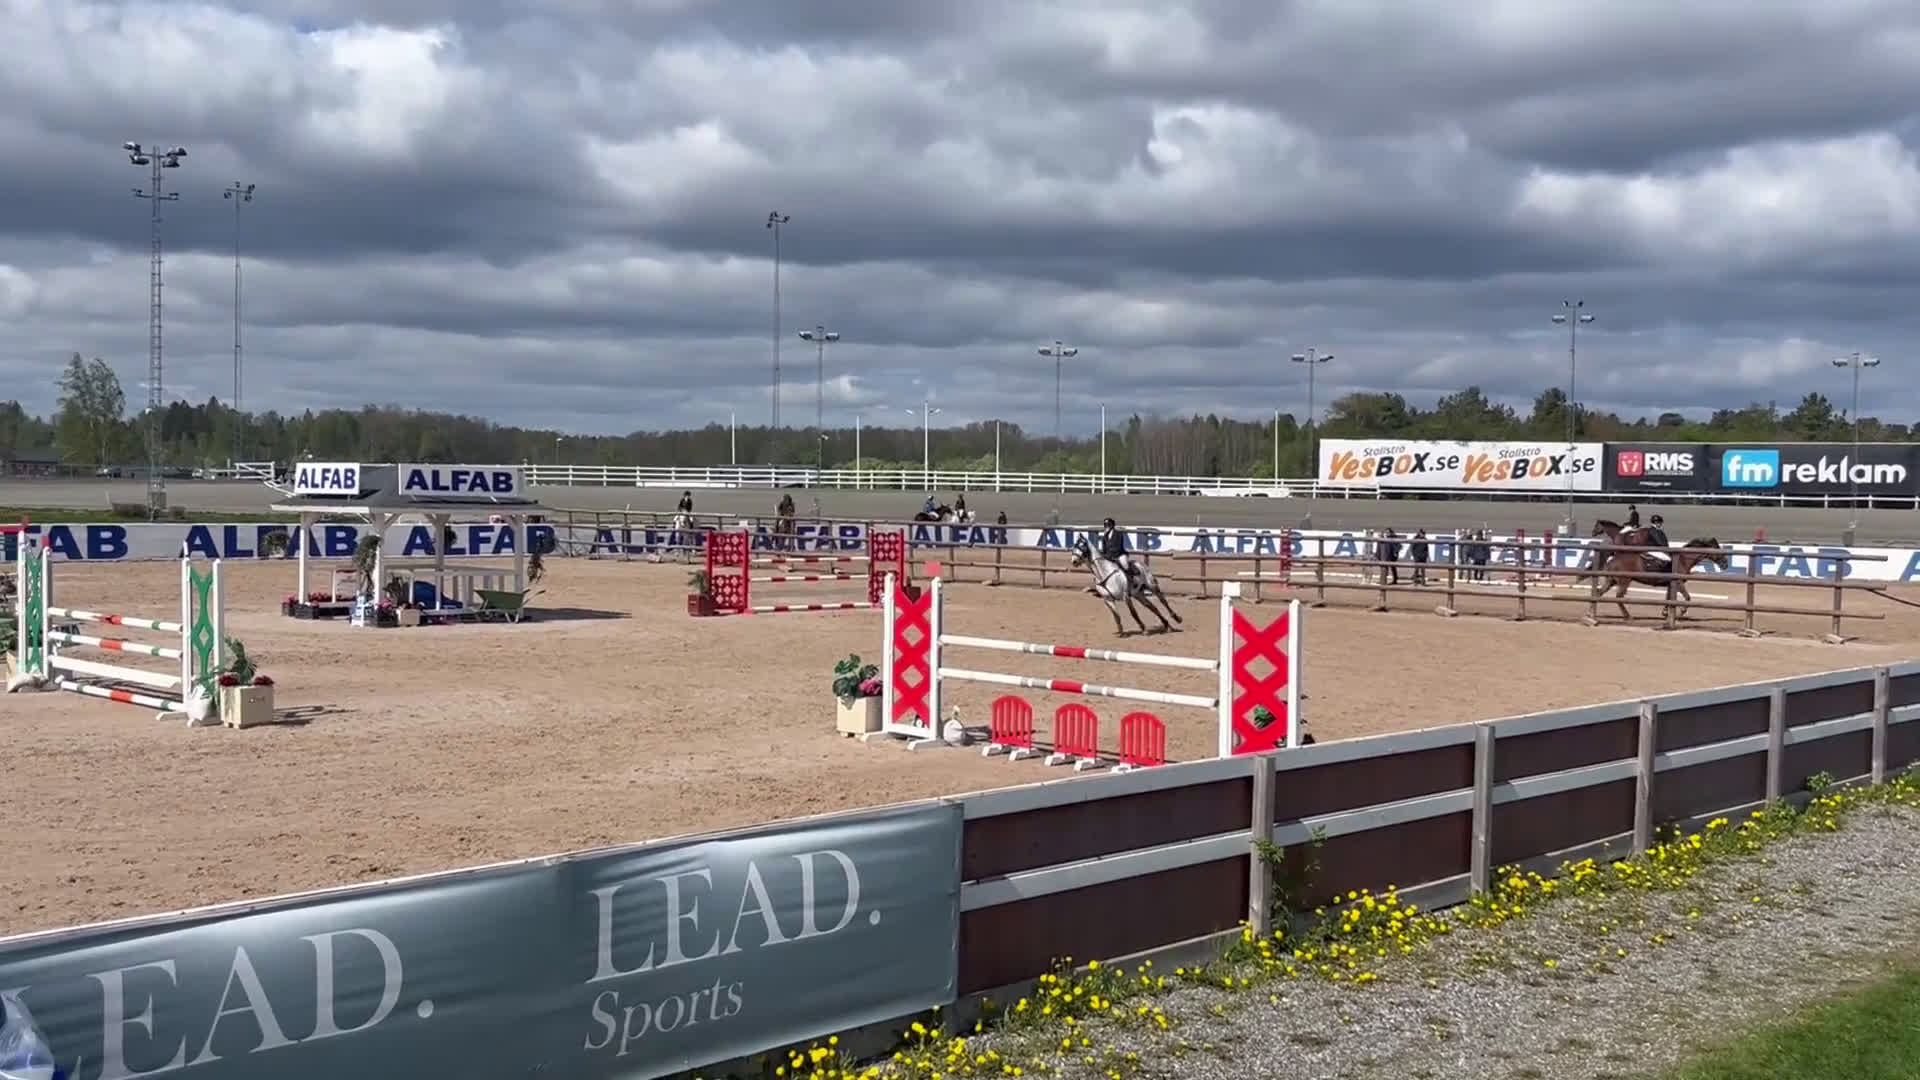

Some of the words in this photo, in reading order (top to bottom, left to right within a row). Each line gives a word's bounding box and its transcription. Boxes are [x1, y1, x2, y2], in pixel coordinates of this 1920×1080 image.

[1328, 450, 1460, 480] YesBOX.se
[1462, 453, 1595, 483] YesBOX.se
[1644, 452, 1694, 471] RMS
[1728, 455, 1774, 483] fm
[1782, 455, 1907, 484] reklam
[298, 468, 356, 489] ALFAB
[405, 469, 513, 492] ALFAB
[751, 526, 860, 550] AFAB
[585, 849, 881, 984] LEAD.
[0, 928, 434, 1080] EAD.
[584, 976, 744, 1057] Sports
